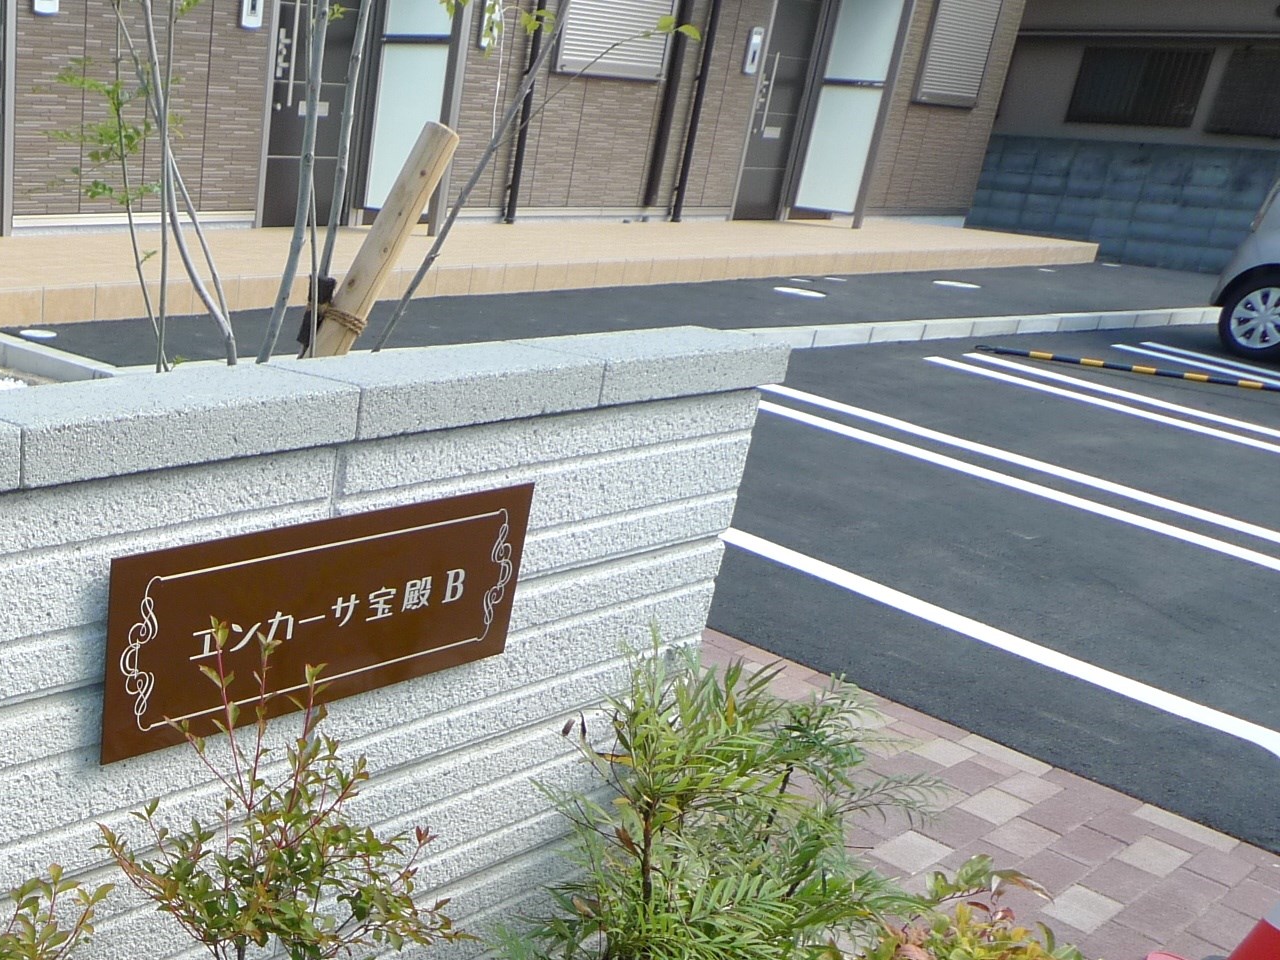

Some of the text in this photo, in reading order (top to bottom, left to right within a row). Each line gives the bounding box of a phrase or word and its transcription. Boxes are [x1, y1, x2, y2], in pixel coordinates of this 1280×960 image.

[189, 568, 466, 660] エンカーサ宝殿 B
